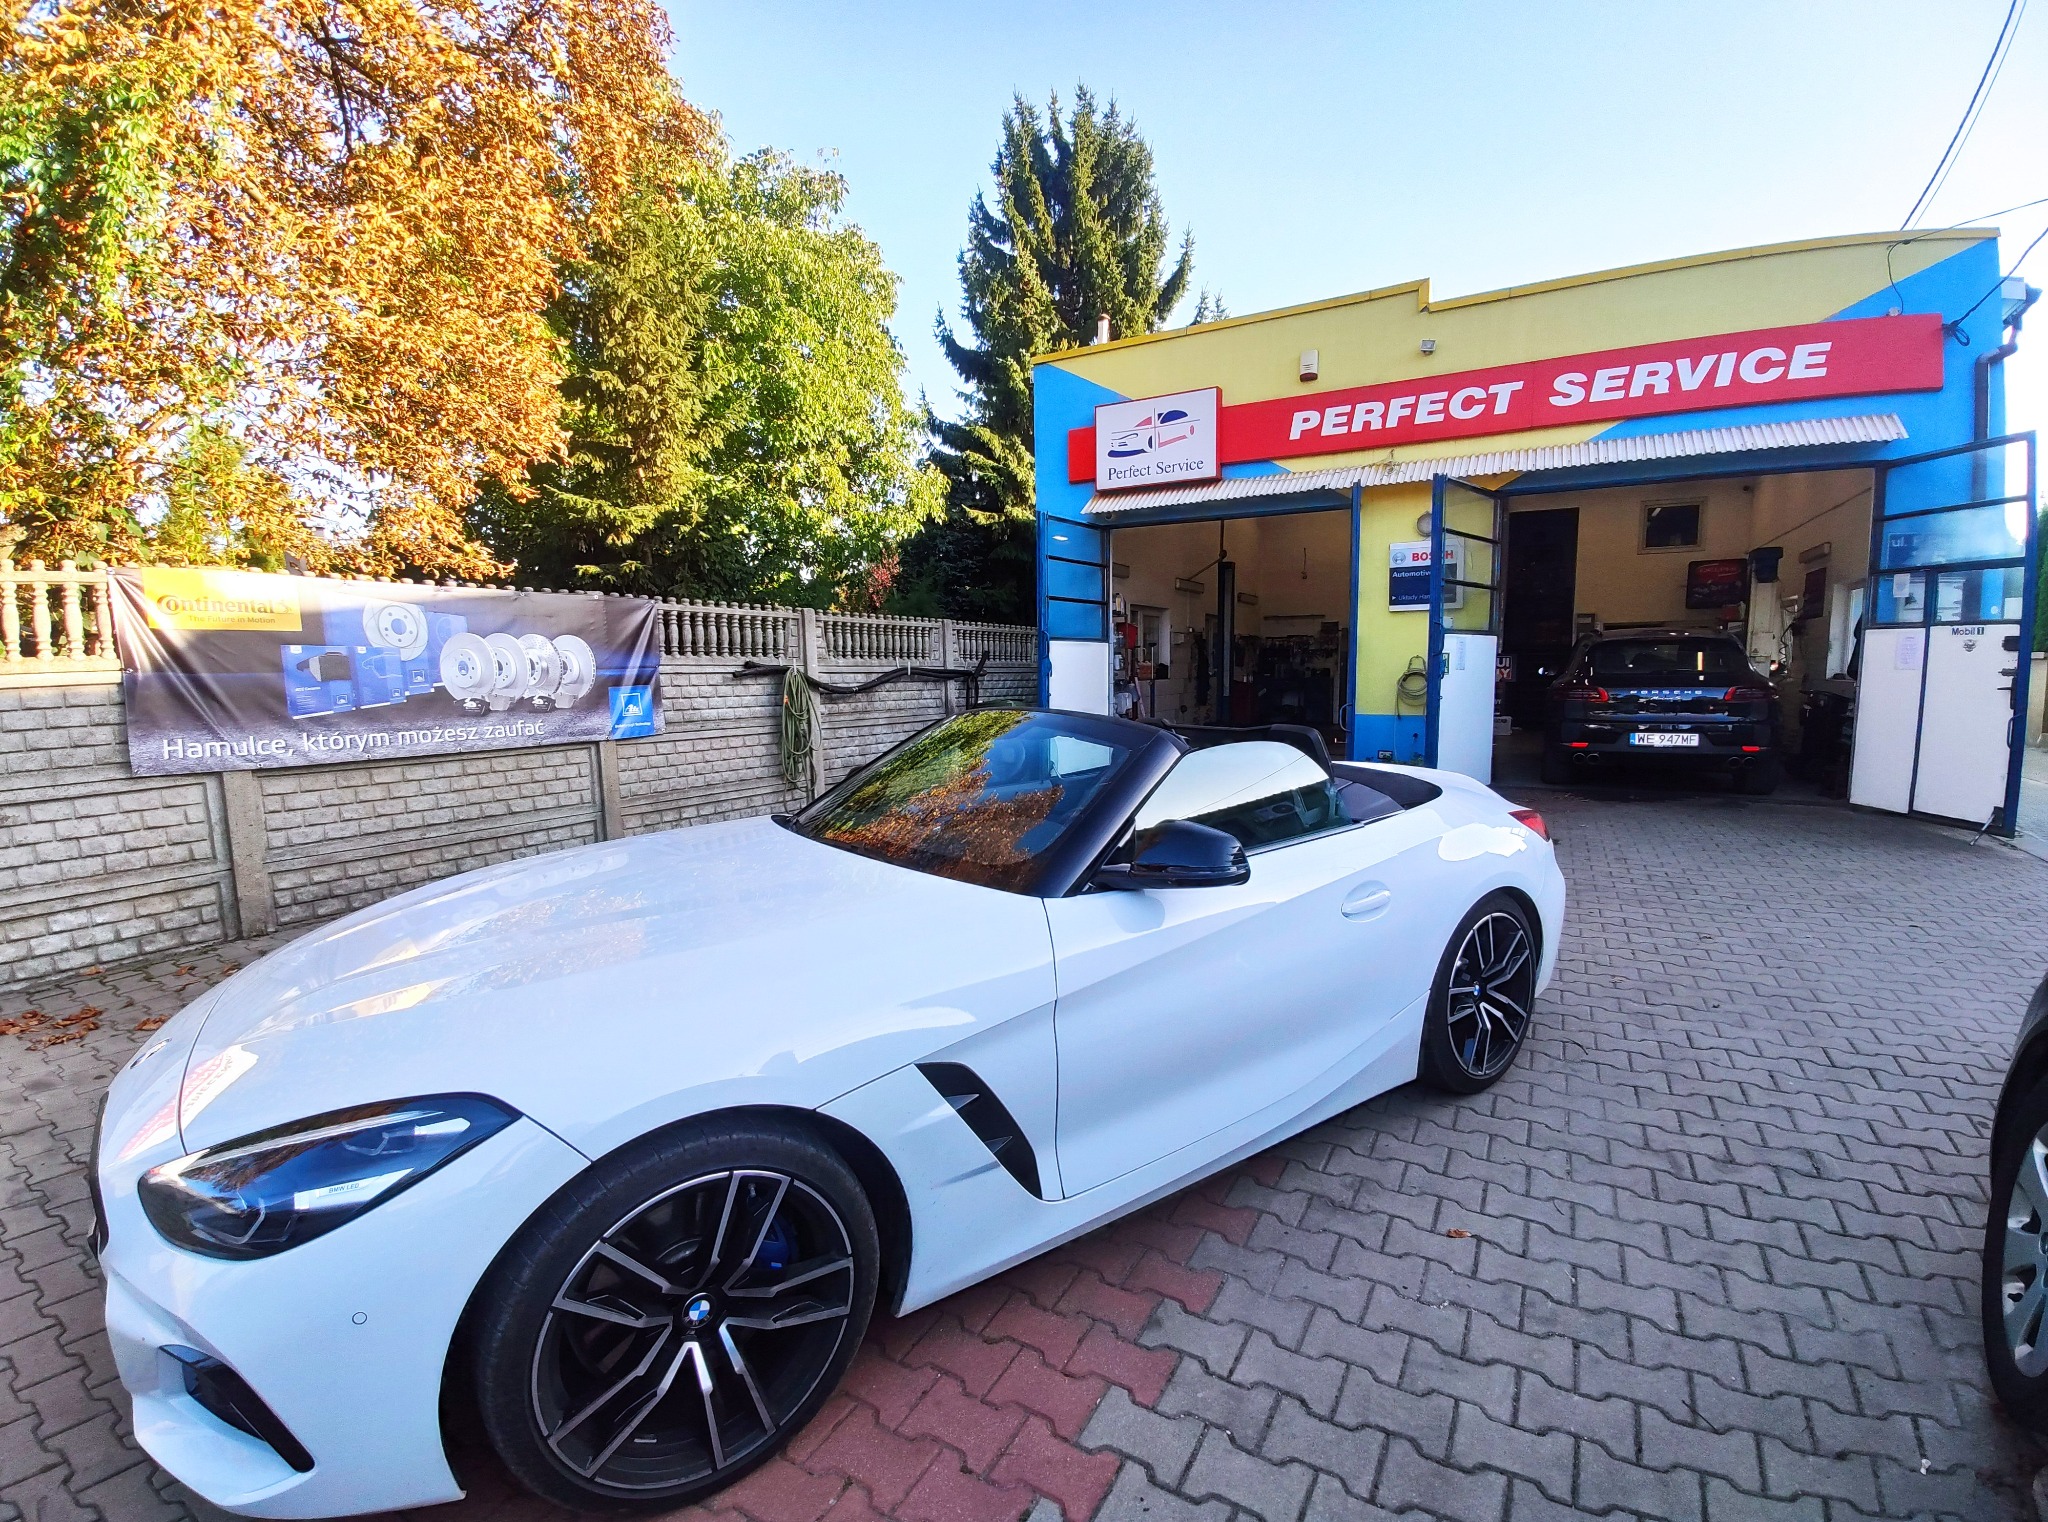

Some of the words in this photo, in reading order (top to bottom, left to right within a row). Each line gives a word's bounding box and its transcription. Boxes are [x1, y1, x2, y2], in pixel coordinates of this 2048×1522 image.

[1289, 381, 1524, 440] PERFECT
[1549, 341, 1833, 407] SERVICE
[1108, 465, 1151, 481] Perfect
[1156, 458, 1204, 475] Service
[1411, 550, 1454, 562] BOH
[1392, 569, 1431, 578] Automotiv
[156, 594, 274, 616] Continental
[189, 615, 205, 623] The
[207, 615, 236, 624] Future
[247, 616, 276, 625] Motion
[1951, 627, 1976, 636] Mobil
[163, 735, 295, 761] Hamulce,
[303, 731, 391, 752] którym
[398, 726, 479, 746] możesz
[484, 720, 545, 739] zaufać
[1638, 734, 1655, 744] WE
[1659, 735, 1697, 745] 947MF
